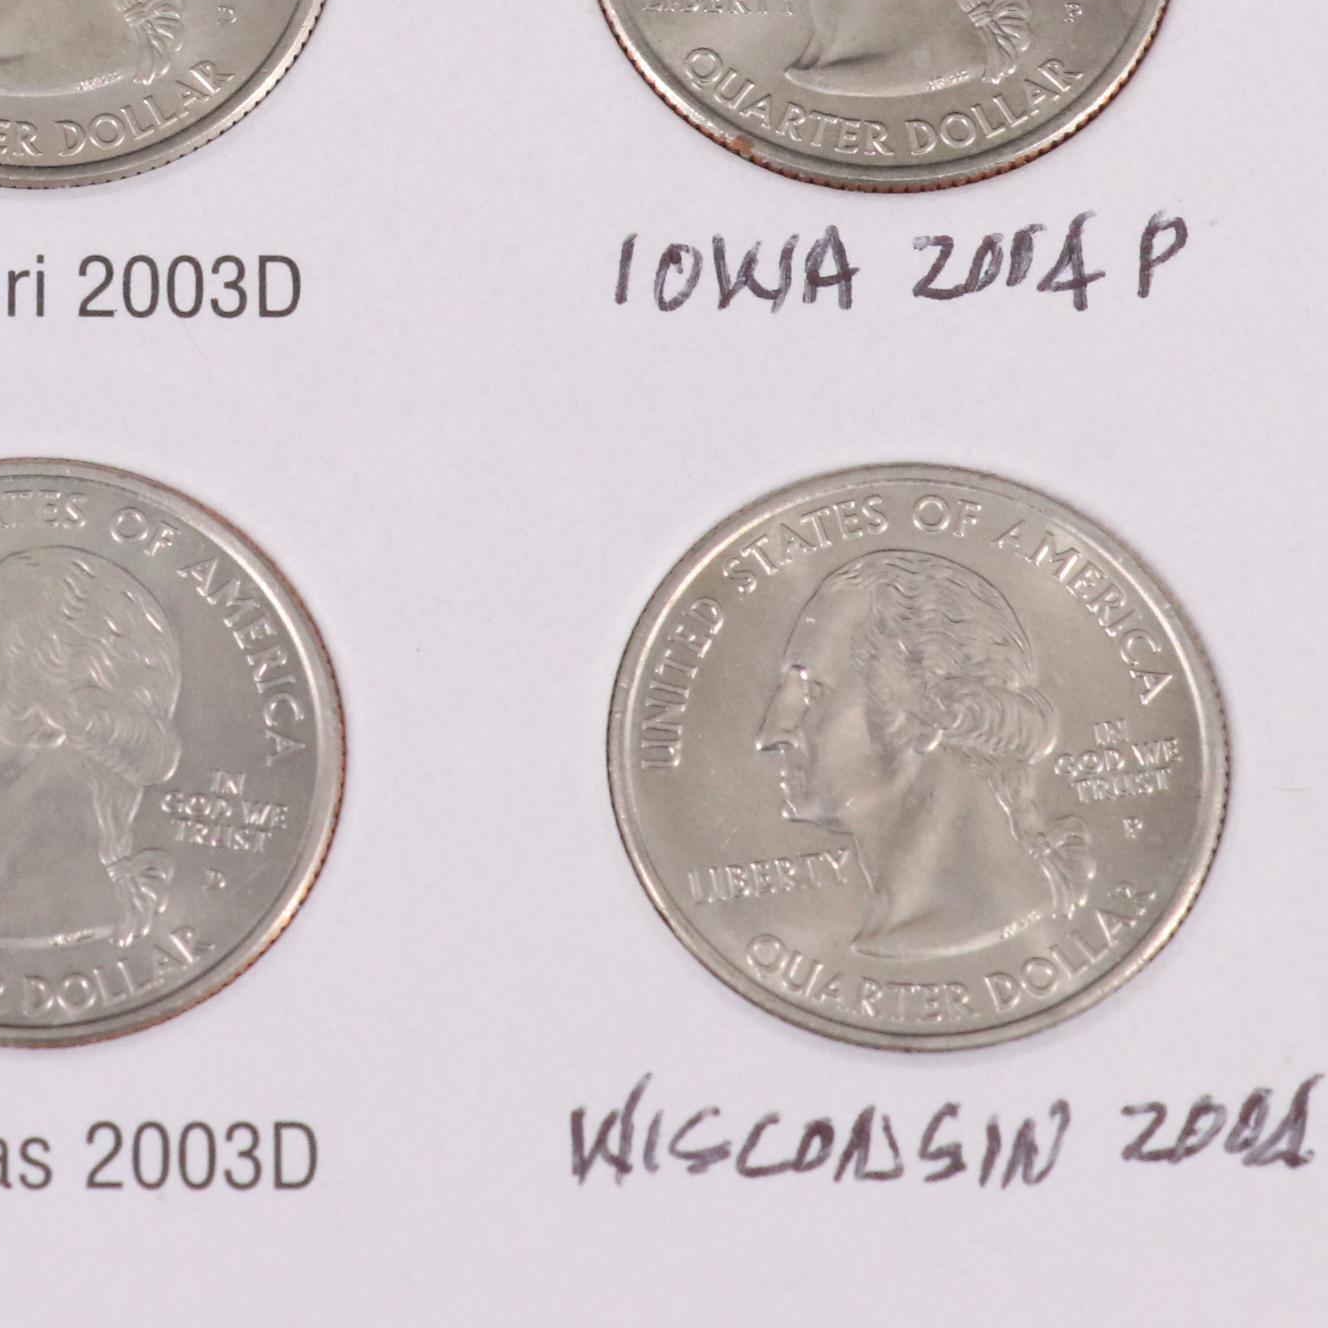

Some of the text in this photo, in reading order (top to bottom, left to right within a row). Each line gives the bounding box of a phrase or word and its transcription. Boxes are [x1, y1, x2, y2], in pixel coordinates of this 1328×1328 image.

[55, 59, 234, 157] DOLLAR
[684, 47, 1082, 157] QUARTER DOLLAR
[78, 254, 301, 319] 2003D
[109, 506, 179, 557] OF
[177, 557, 306, 767] AMERICA
[641, 493, 1173, 770] UNITED STATES OF AMERICA
[1054, 739, 1181, 779] GOD WE
[1092, 721, 1128, 744] IN
[161, 790, 288, 828] GOD WE
[211, 771, 245, 795] IN
[1073, 770, 1171, 803] TRUST
[172, 818, 273, 852] TRUST
[687, 848, 852, 904] LIBERTY
[22, 927, 214, 1016] DOLLAR
[745, 884, 1158, 1023] QUARTER DOLLAR
[85, 1121, 318, 1190] 2003D
